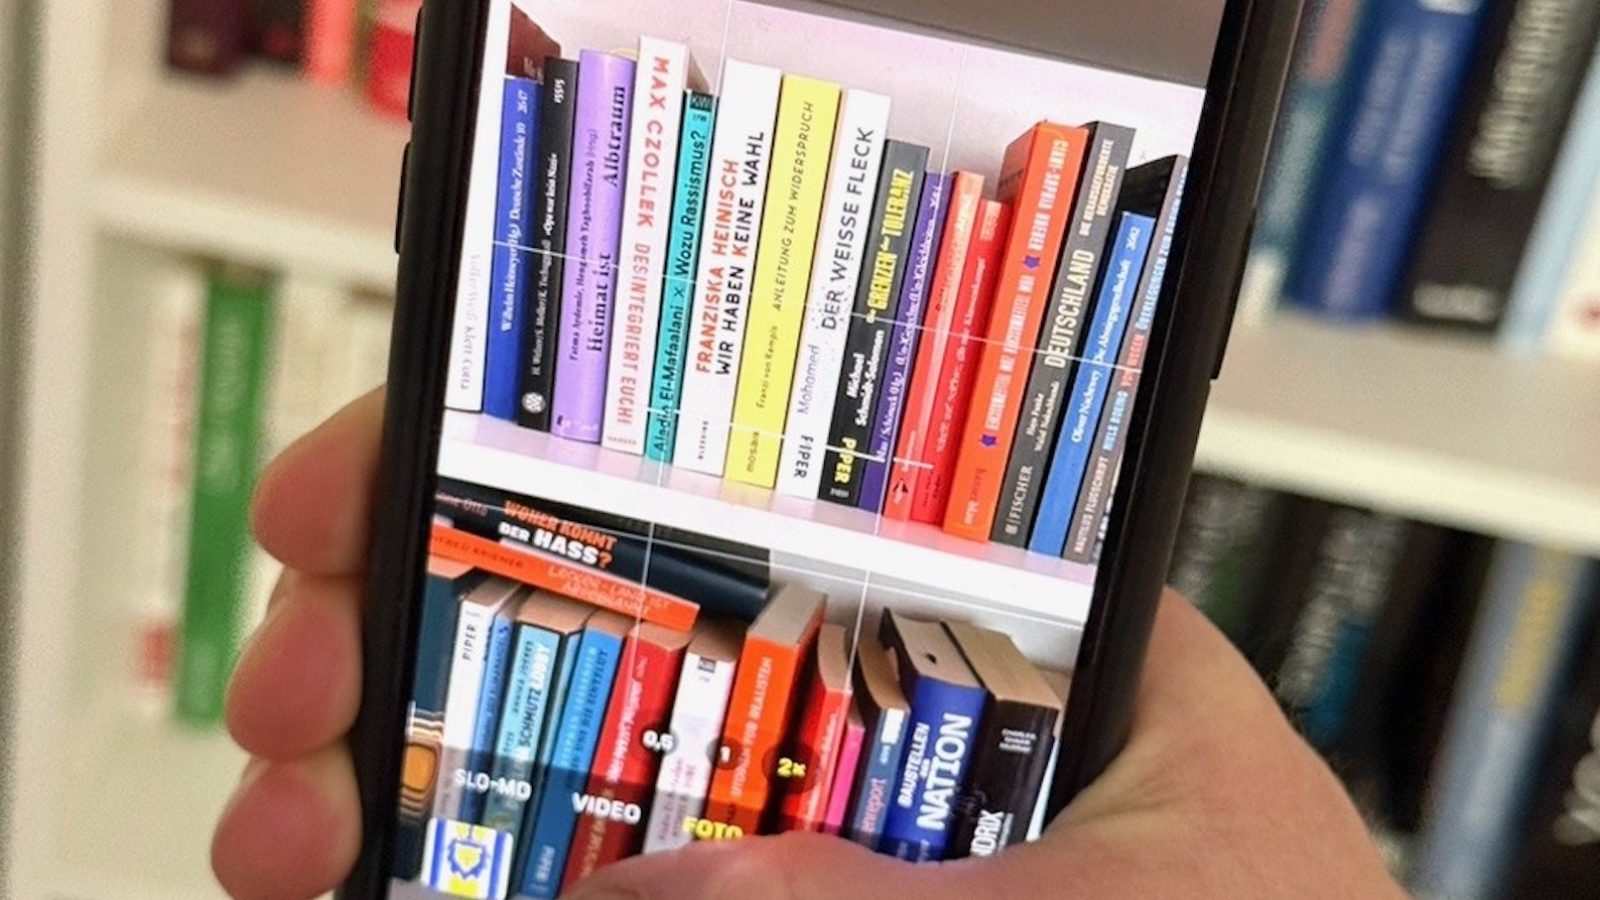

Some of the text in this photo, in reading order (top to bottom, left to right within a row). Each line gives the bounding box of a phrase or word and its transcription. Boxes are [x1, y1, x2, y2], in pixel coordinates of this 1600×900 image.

[638, 57, 669, 226] MAX CZOLLEK
[680, 130, 706, 226] Rassismus?
[772, 102, 814, 311] ANLEITUNG ZUM WIDERSPRUCH
[881, 168, 914, 237] TOLERANZ
[586, 86, 626, 352] Heimat ist Albtraum
[674, 230, 695, 277] Wozu
[716, 131, 764, 375] WIR HABEN KEINE WAHL
[821, 127, 874, 330] DER WEISSE FLECK
[696, 159, 739, 374] FRANZISKA HEINISCH
[868, 251, 898, 309] GRENZEN
[617, 243, 649, 425] DESINTEGRIERT EUCH!
[1044, 249, 1095, 368] DEUTSCHLAND
[659, 306, 683, 401] El-Mafaalani
[797, 343, 820, 415] Mohamed
[846, 352, 865, 398] Michael
[855, 329, 885, 427] Schmidt-Salomon
[653, 403, 673, 452] Aladin
[834, 437, 857, 483] PIPER
[504, 500, 618, 551] WOHER KOMMT
[1009, 465, 1033, 518] FISCHER
[498, 521, 613, 569] DER HASS?
[462, 622, 477, 662] PIPER
[720, 746, 731, 763] 1
[897, 722, 930, 808] BAUSTELLEN
[916, 712, 972, 831] NATION
[572, 791, 642, 824] VIDEO
[682, 815, 743, 842] FOTO
